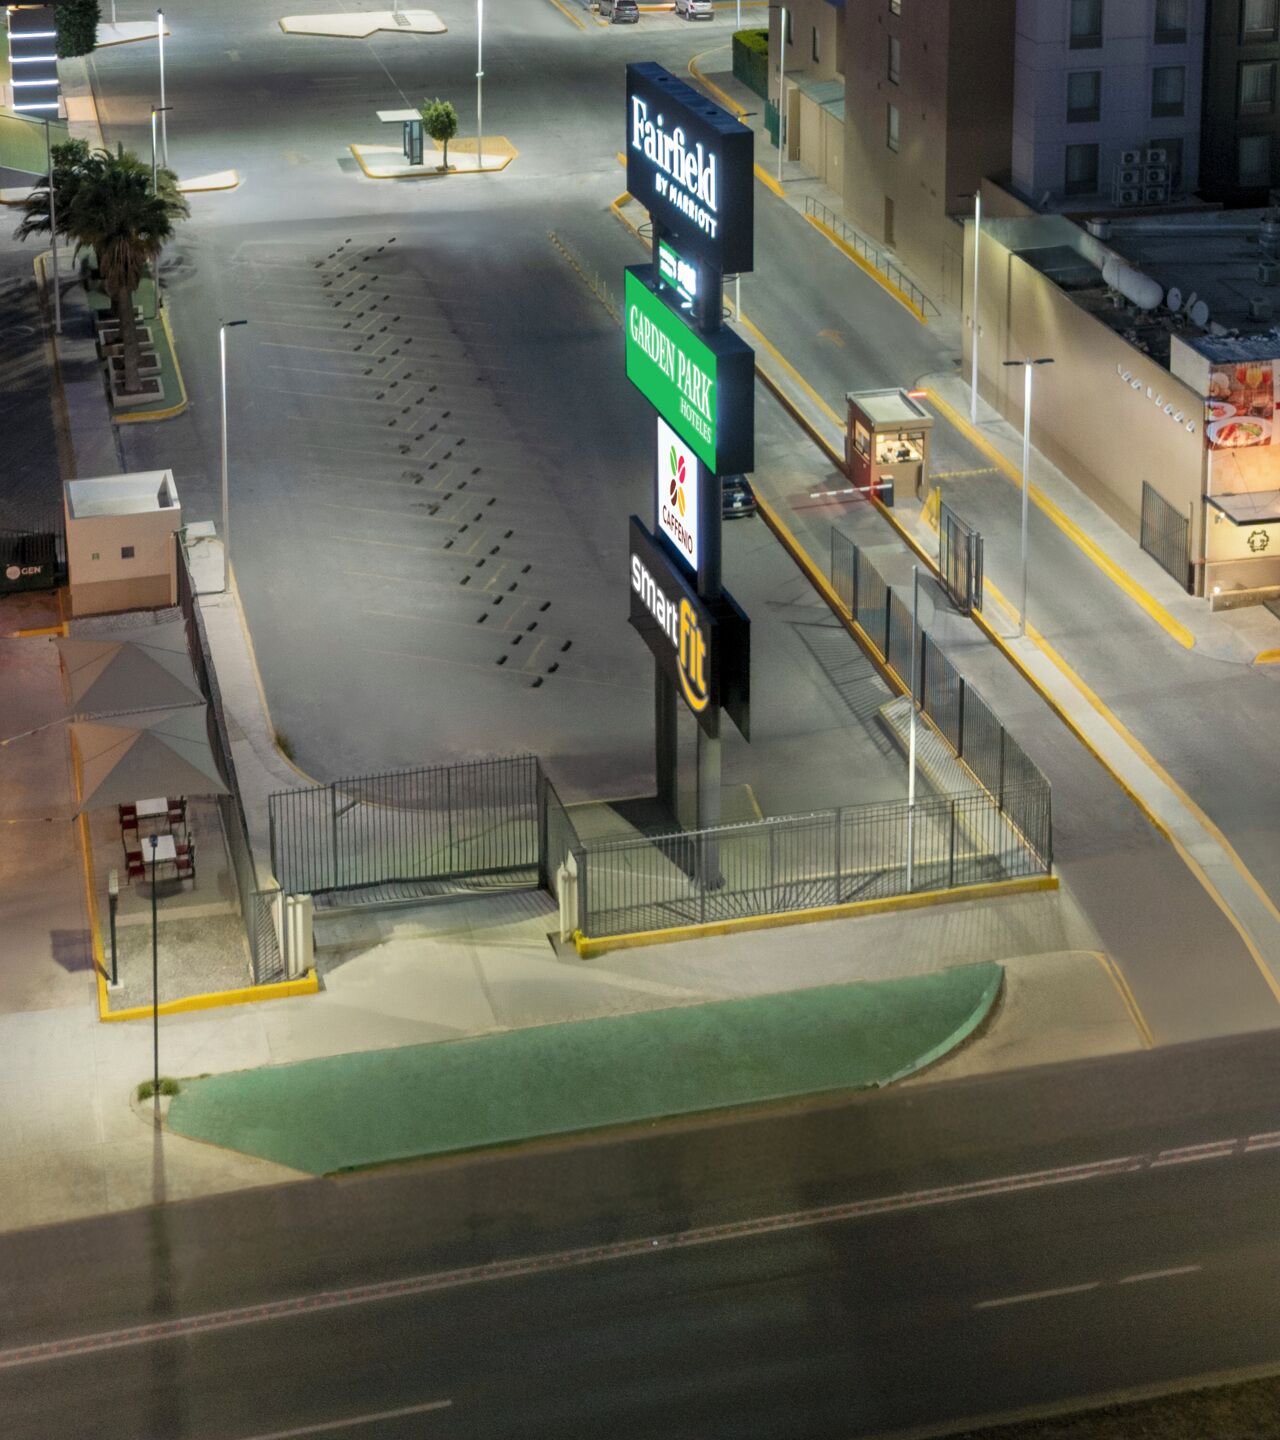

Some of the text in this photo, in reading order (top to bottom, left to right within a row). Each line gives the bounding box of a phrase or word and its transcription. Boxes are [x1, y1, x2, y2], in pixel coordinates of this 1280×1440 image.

[631, 95, 718, 211] Fairfield
[656, 172, 717, 238] BY MARRIOTT
[630, 304, 676, 382] GARDEN
[677, 349, 713, 422] PARK
[680, 396, 712, 444] HOTELES
[662, 504, 693, 554] CAFFENIO
